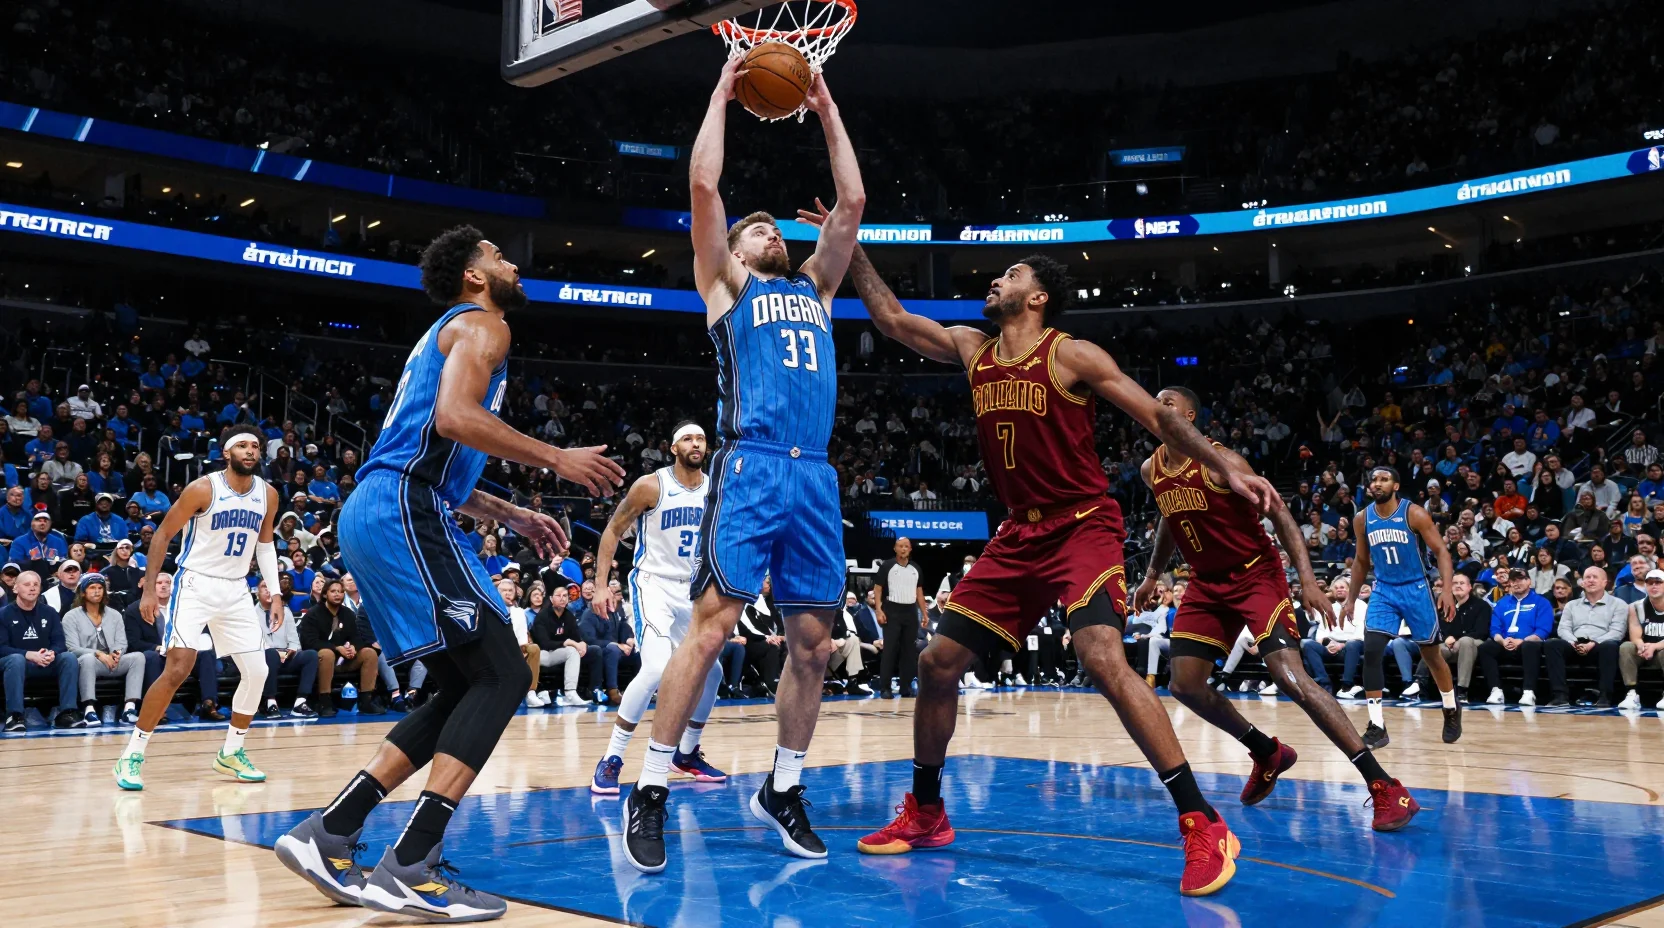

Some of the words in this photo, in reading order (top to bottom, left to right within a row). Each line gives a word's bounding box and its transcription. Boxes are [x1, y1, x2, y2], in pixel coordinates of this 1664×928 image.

[780, 328, 819, 372] 33
[996, 422, 1016, 469] 7
[224, 532, 248, 557] 19
